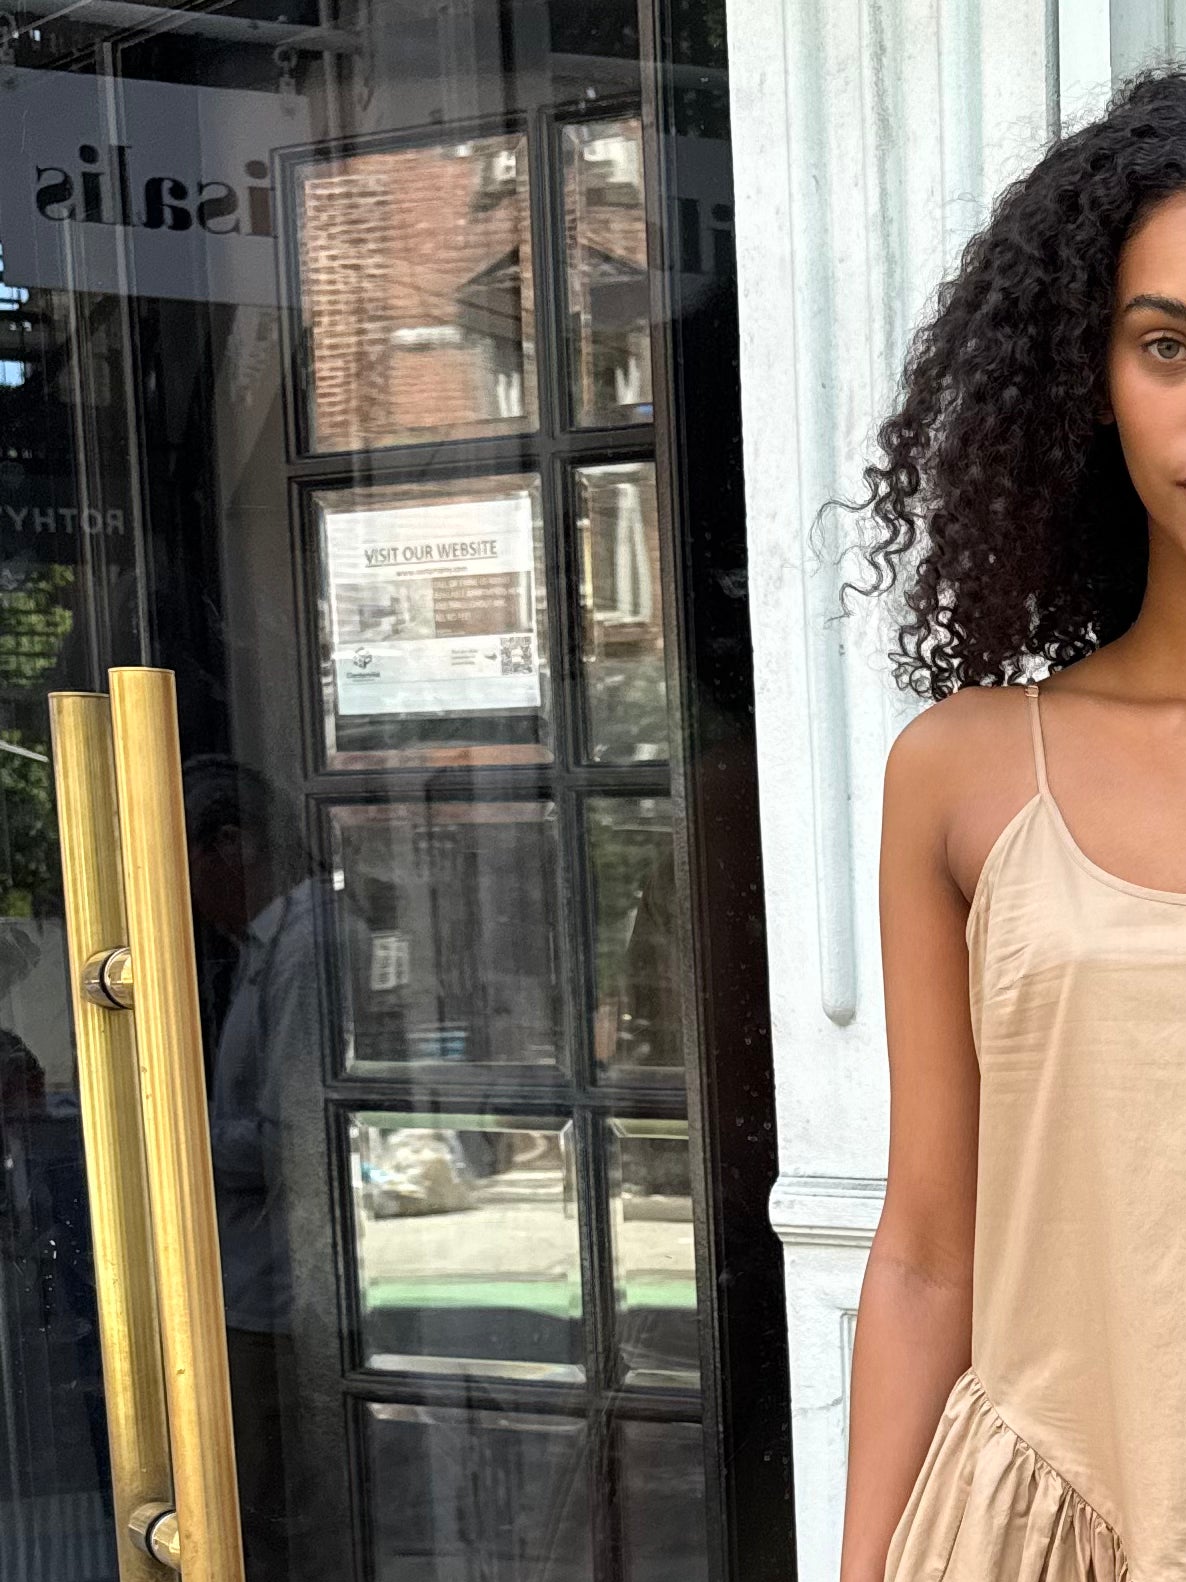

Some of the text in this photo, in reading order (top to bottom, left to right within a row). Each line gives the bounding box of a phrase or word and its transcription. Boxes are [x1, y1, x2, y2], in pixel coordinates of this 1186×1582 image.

[365, 540, 497, 565] VISIT OUR WEBSITE
